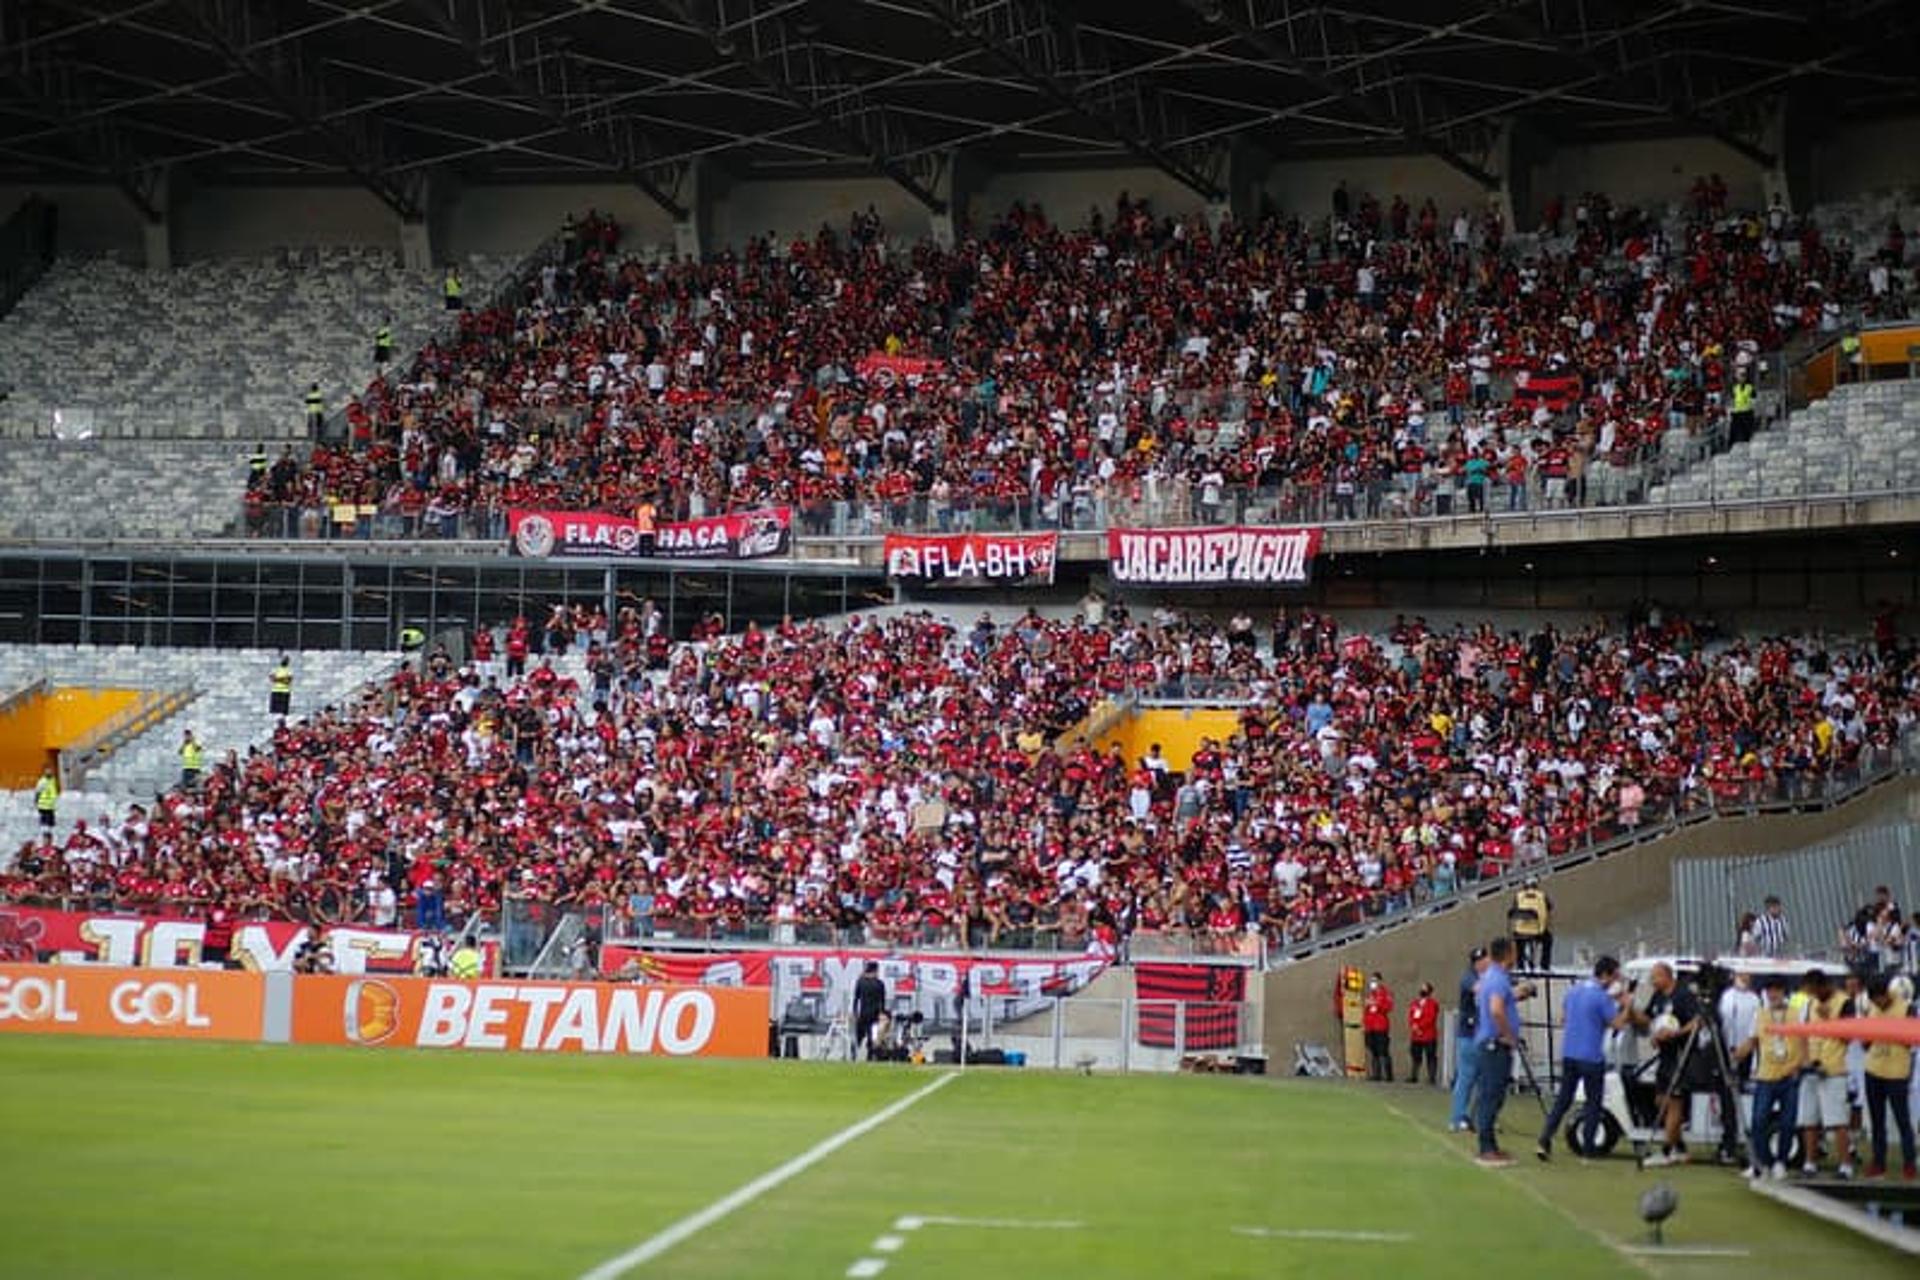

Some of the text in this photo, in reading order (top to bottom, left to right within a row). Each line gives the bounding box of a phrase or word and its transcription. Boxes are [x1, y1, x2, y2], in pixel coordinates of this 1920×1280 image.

[922, 542, 1026, 578] FLA-BH
[109, 980, 211, 1027] GOL
[416, 982, 716, 1055] BETANO
